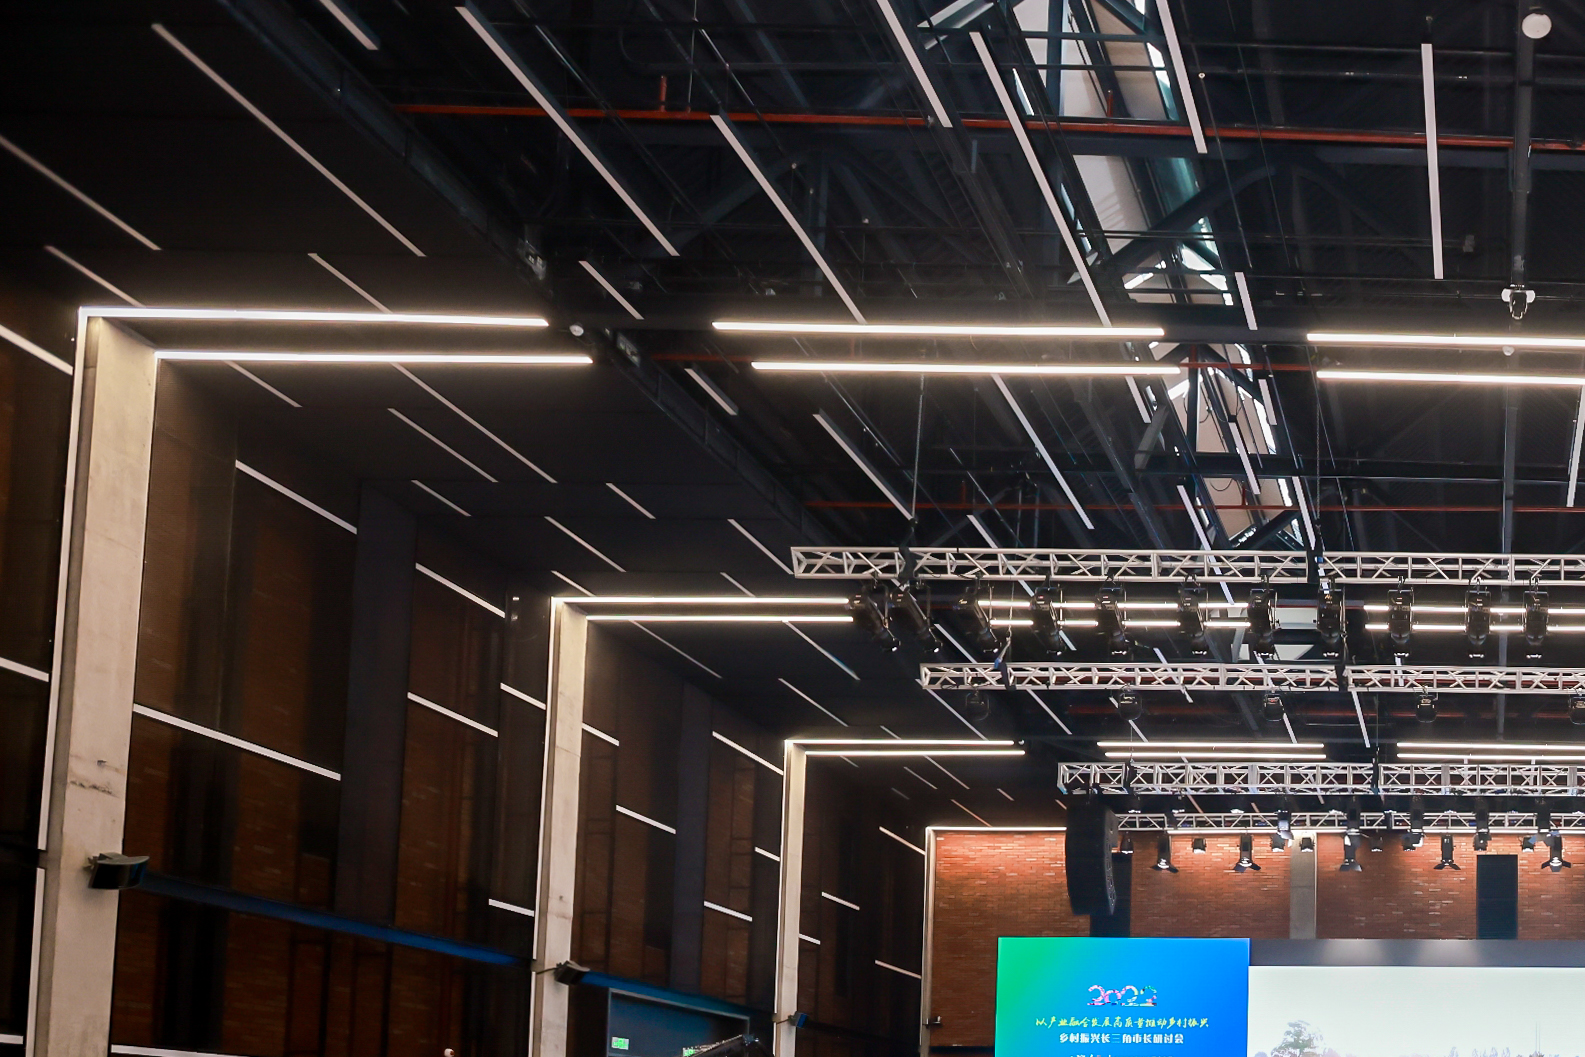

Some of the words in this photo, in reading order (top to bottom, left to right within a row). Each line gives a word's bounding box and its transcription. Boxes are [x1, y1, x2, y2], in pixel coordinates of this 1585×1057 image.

[1087, 985, 1157, 1007] 2022
[1059, 1033, 1184, 1044] 乡村振兴长三角市长研讨会
